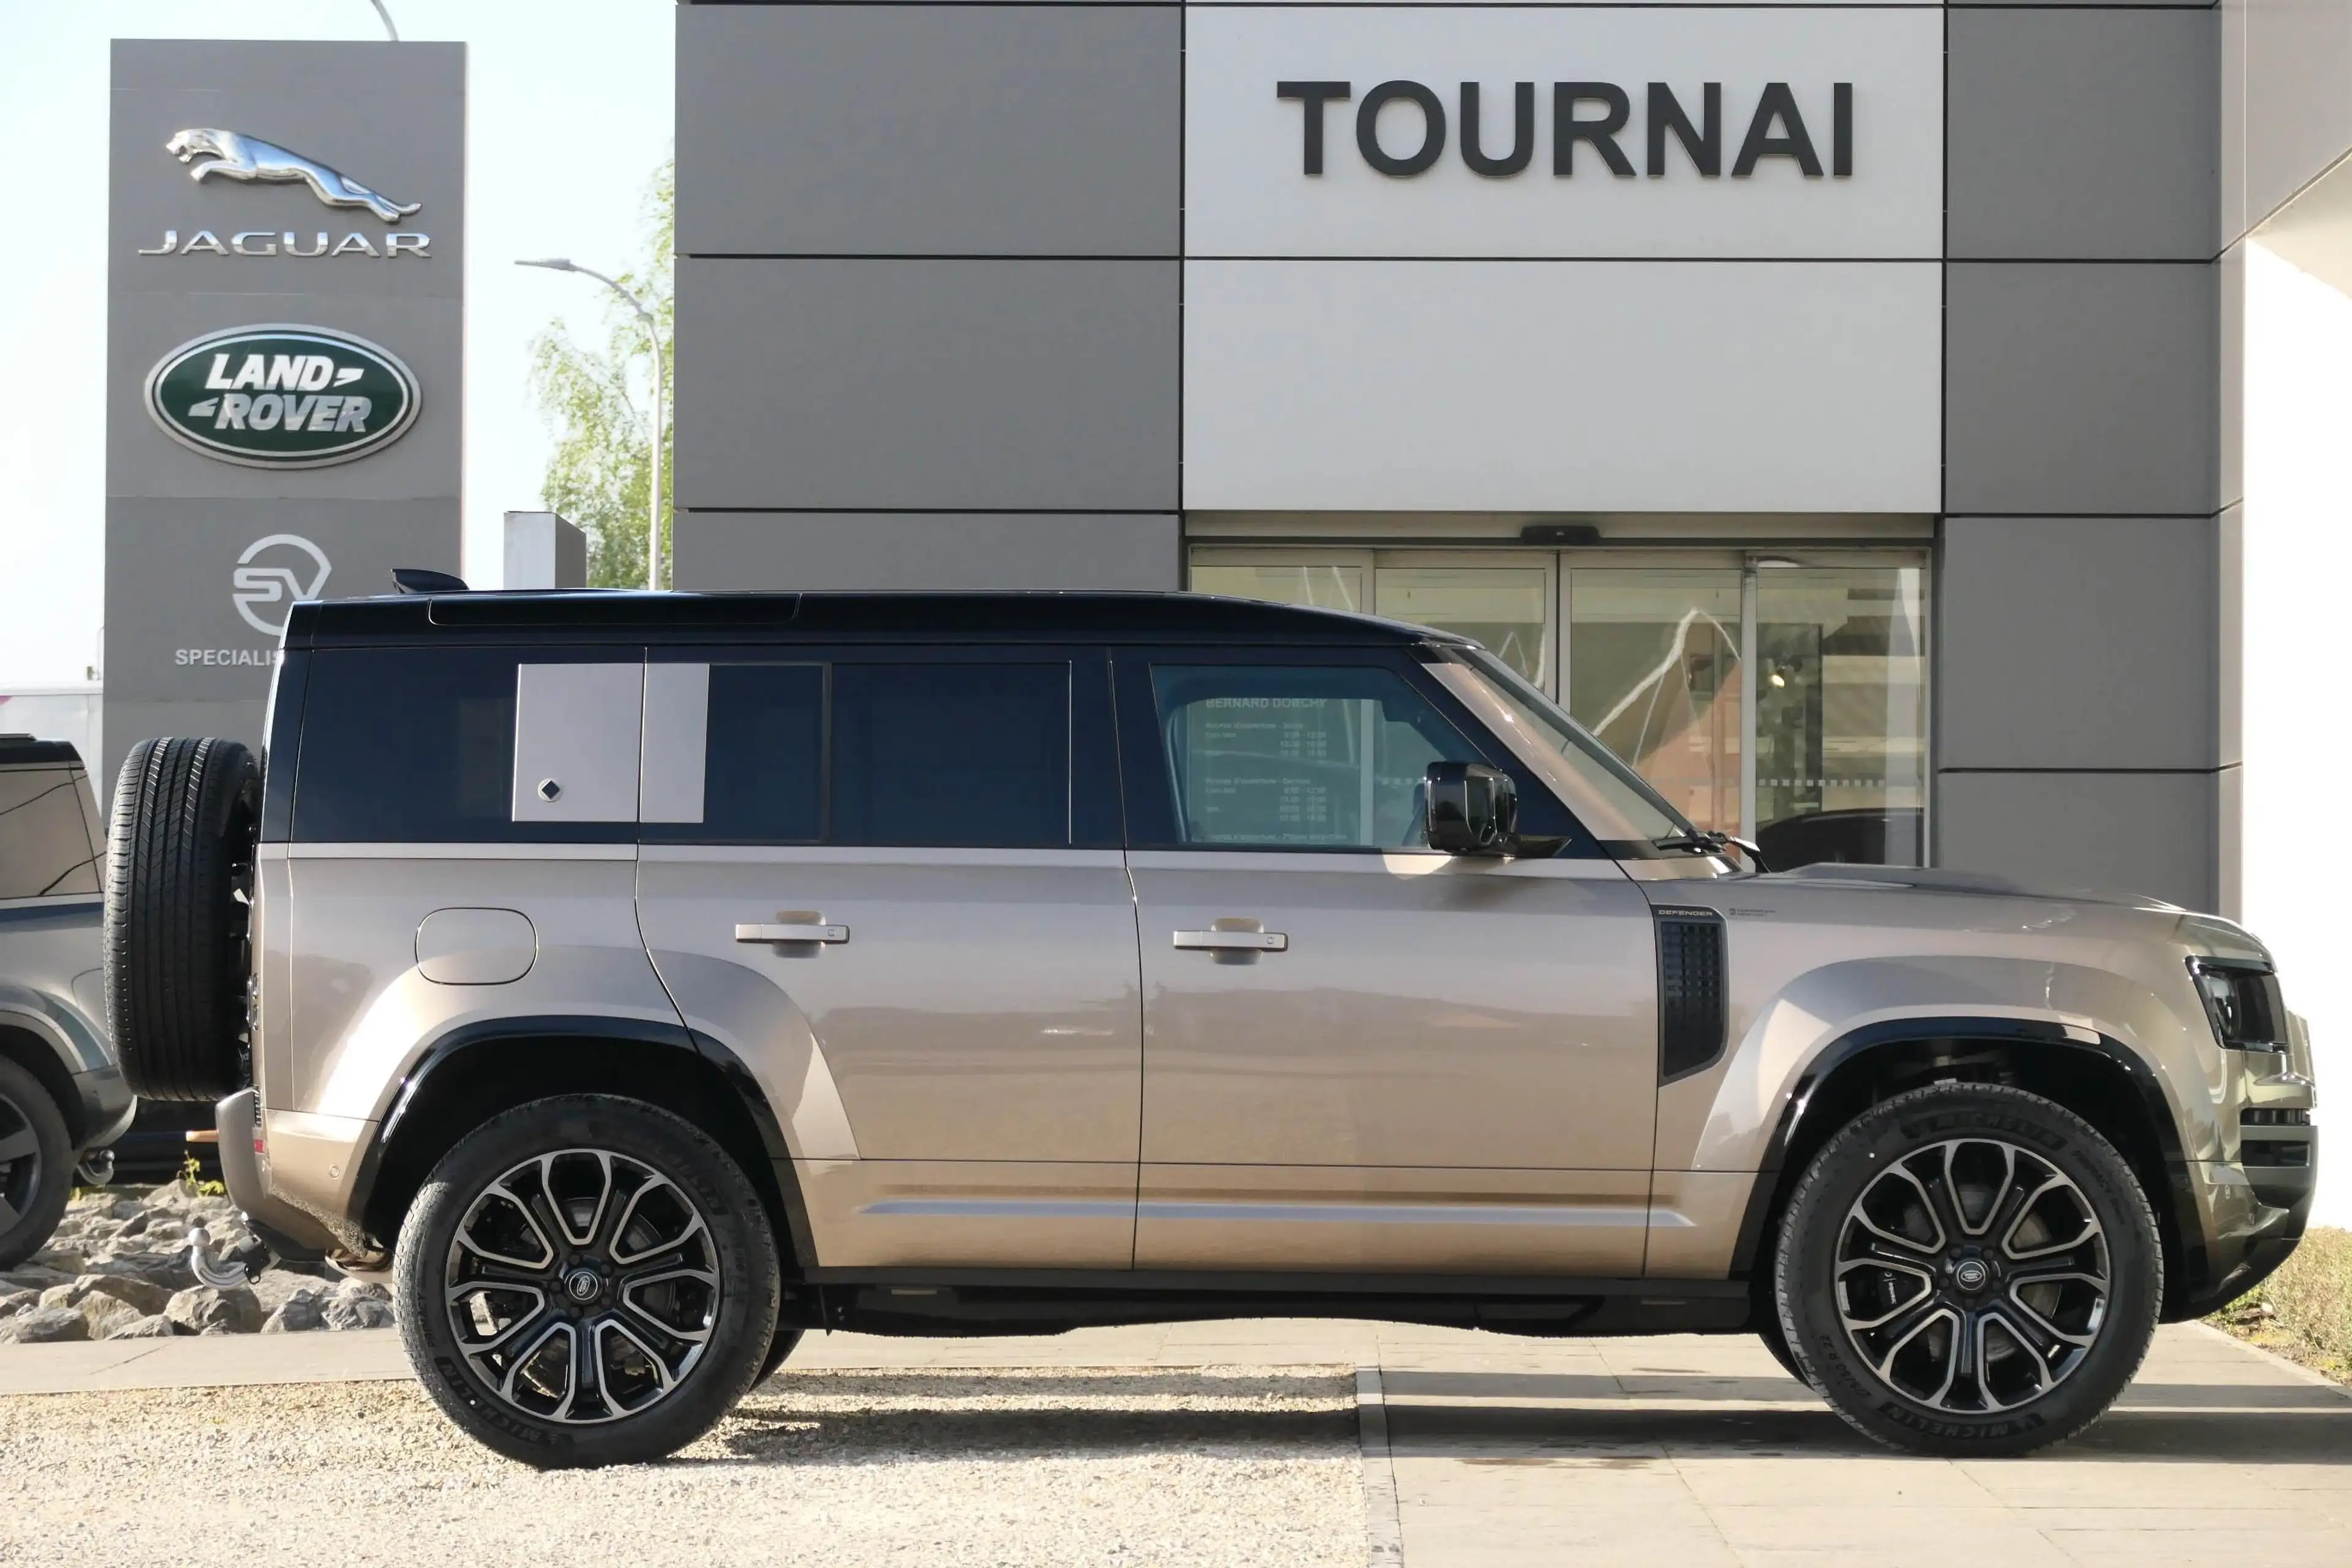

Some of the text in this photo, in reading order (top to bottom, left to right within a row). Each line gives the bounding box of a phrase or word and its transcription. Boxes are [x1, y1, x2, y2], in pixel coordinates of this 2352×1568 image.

[1276, 80, 1853, 178] TOURNAI
[138, 230, 432, 258] JAGUAR
[205, 354, 334, 390] LAND
[215, 394, 372, 432] ROVER
[1206, 698, 1268, 708] BERNARD
[442, 1364, 541, 1444] MICHELIN
[1886, 1406, 2009, 1438] MICHELIN
